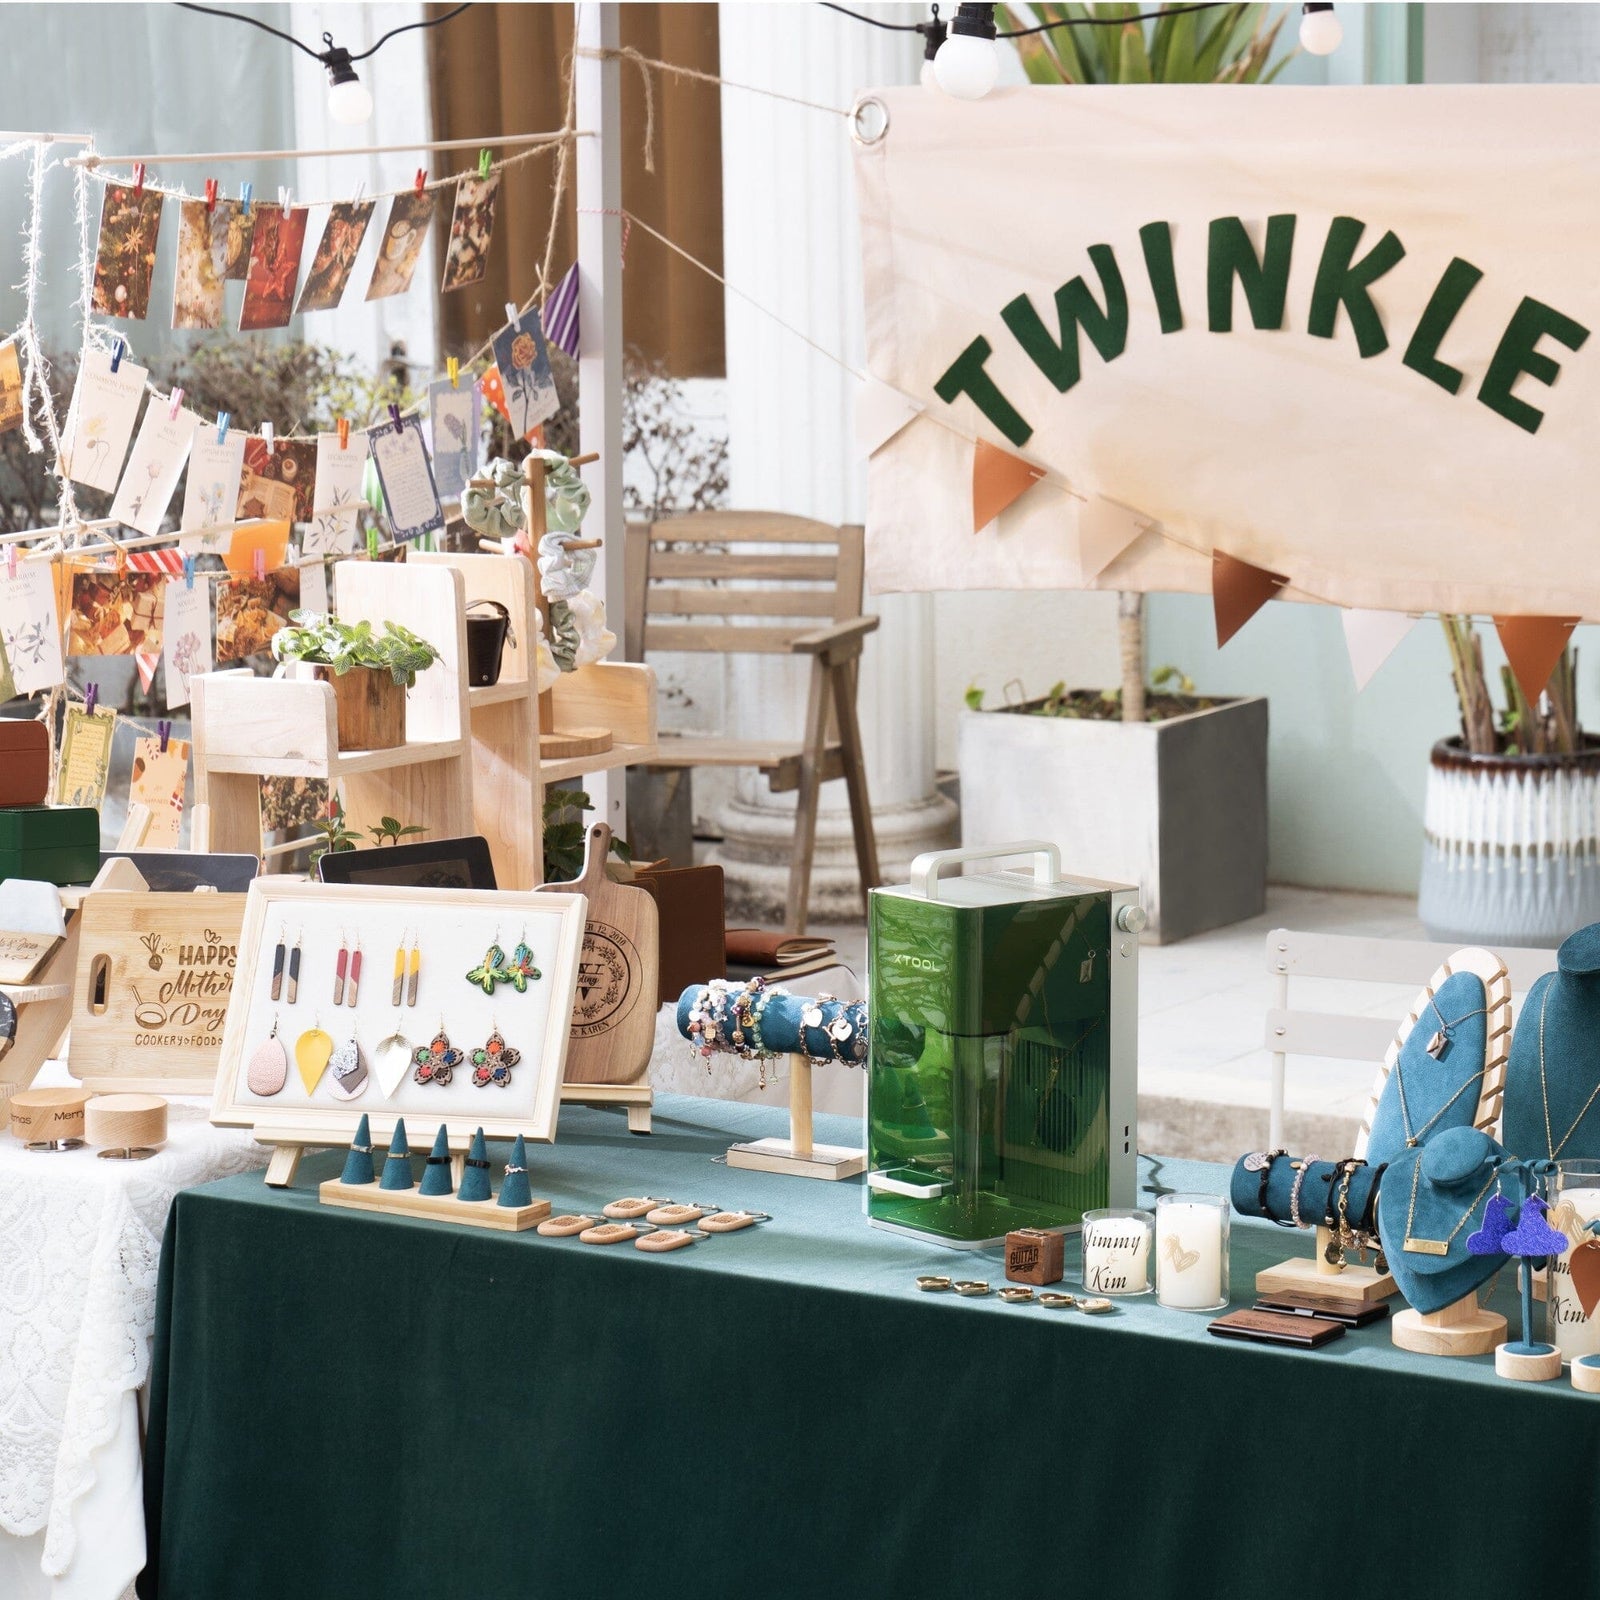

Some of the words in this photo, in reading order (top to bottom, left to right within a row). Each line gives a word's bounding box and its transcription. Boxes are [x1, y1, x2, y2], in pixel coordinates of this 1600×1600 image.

[933, 213, 1591, 448] TWINKLE
[609, 930, 627, 946] 2010
[581, 1020, 610, 1036] KAREN
[1083, 1220, 1141, 1255] Jimmy
[1010, 1247, 1039, 1265] GUITAR
[1091, 1266, 1127, 1293] Kim
[1552, 1296, 1586, 1325] Kim
